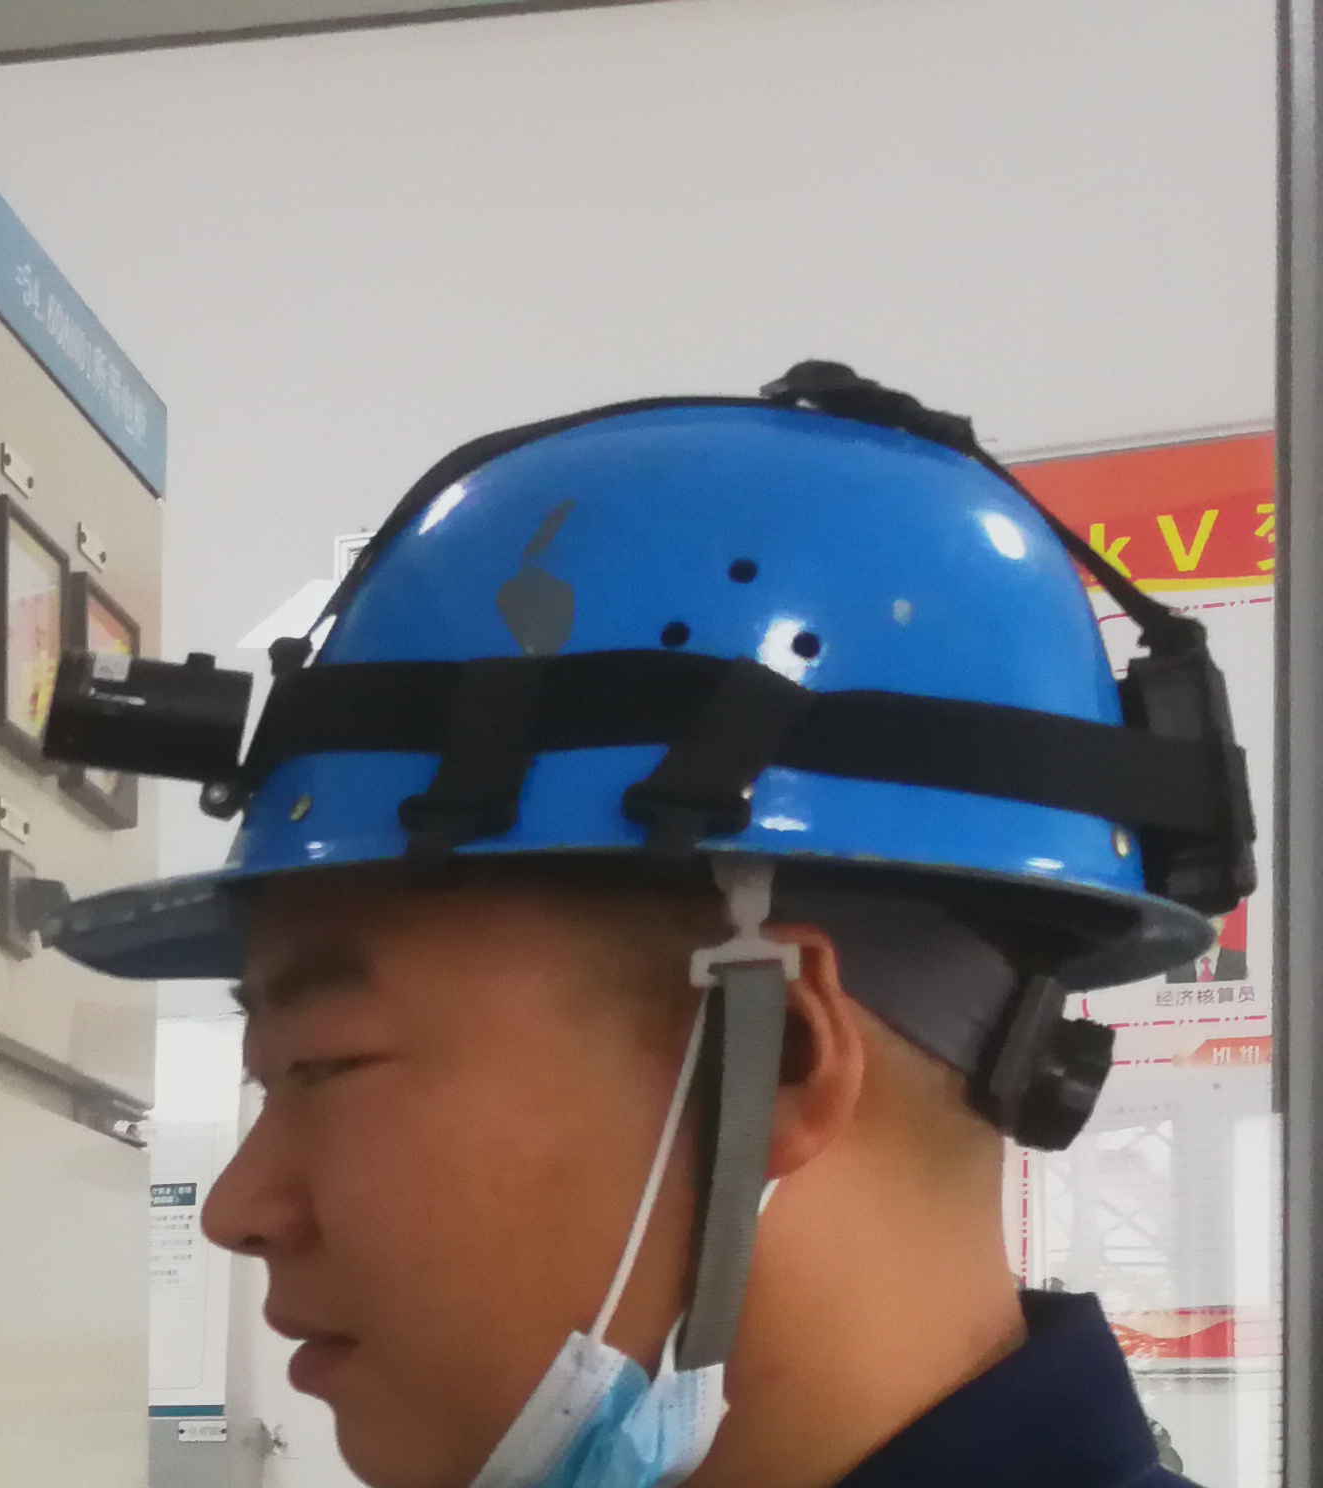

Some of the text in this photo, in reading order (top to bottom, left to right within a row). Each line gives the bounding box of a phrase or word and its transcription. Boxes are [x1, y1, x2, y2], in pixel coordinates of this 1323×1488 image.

[1155, 985, 1256, 1007] 经济核算员
